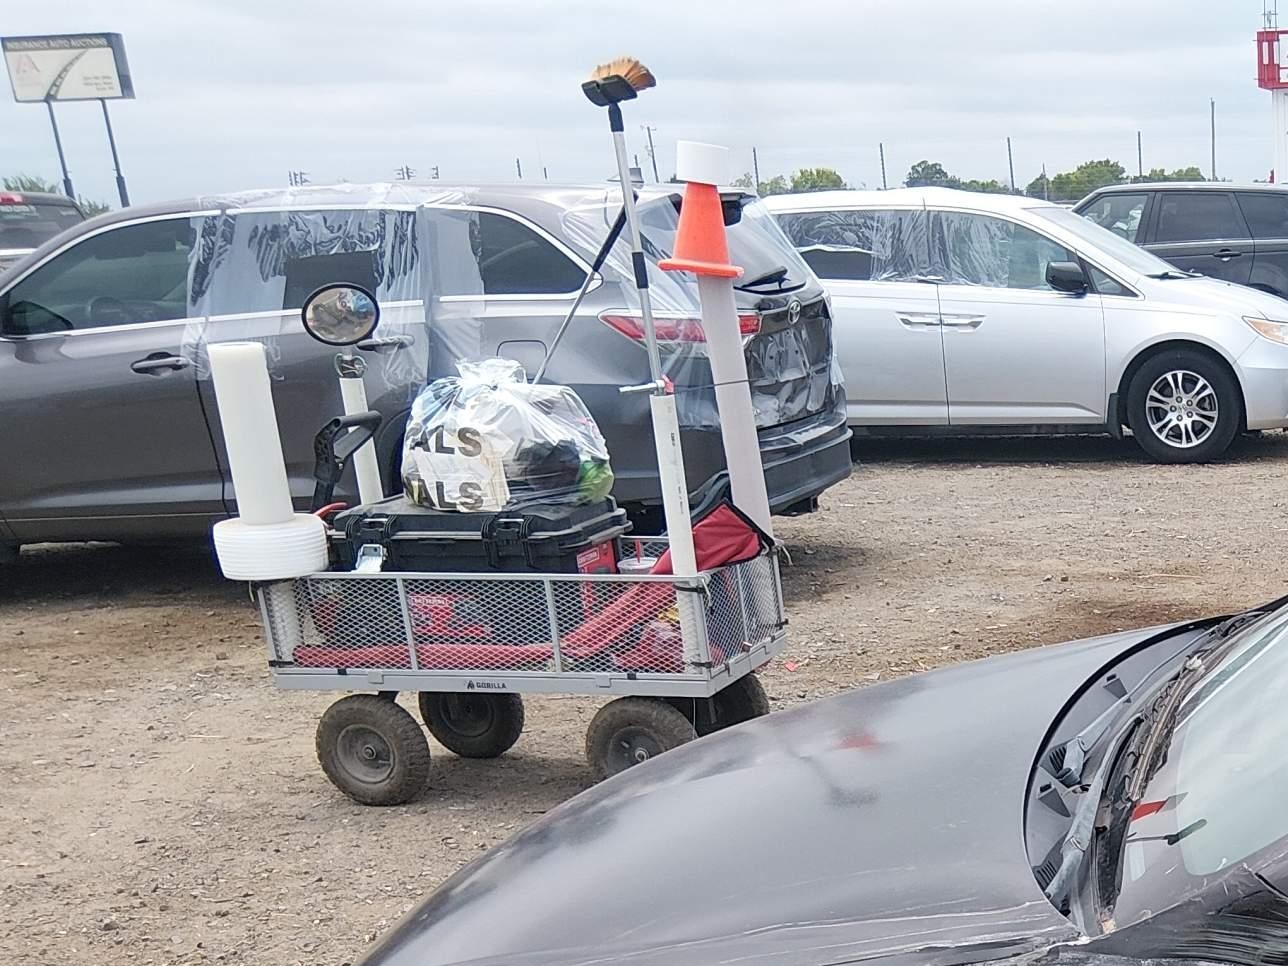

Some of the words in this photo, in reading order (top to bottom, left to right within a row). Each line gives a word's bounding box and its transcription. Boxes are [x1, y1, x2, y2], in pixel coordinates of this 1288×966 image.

[49, 39, 70, 49] AUTO
[70, 38, 108, 48] AUCTIONS
[476, 682, 507, 690] GORILLA
